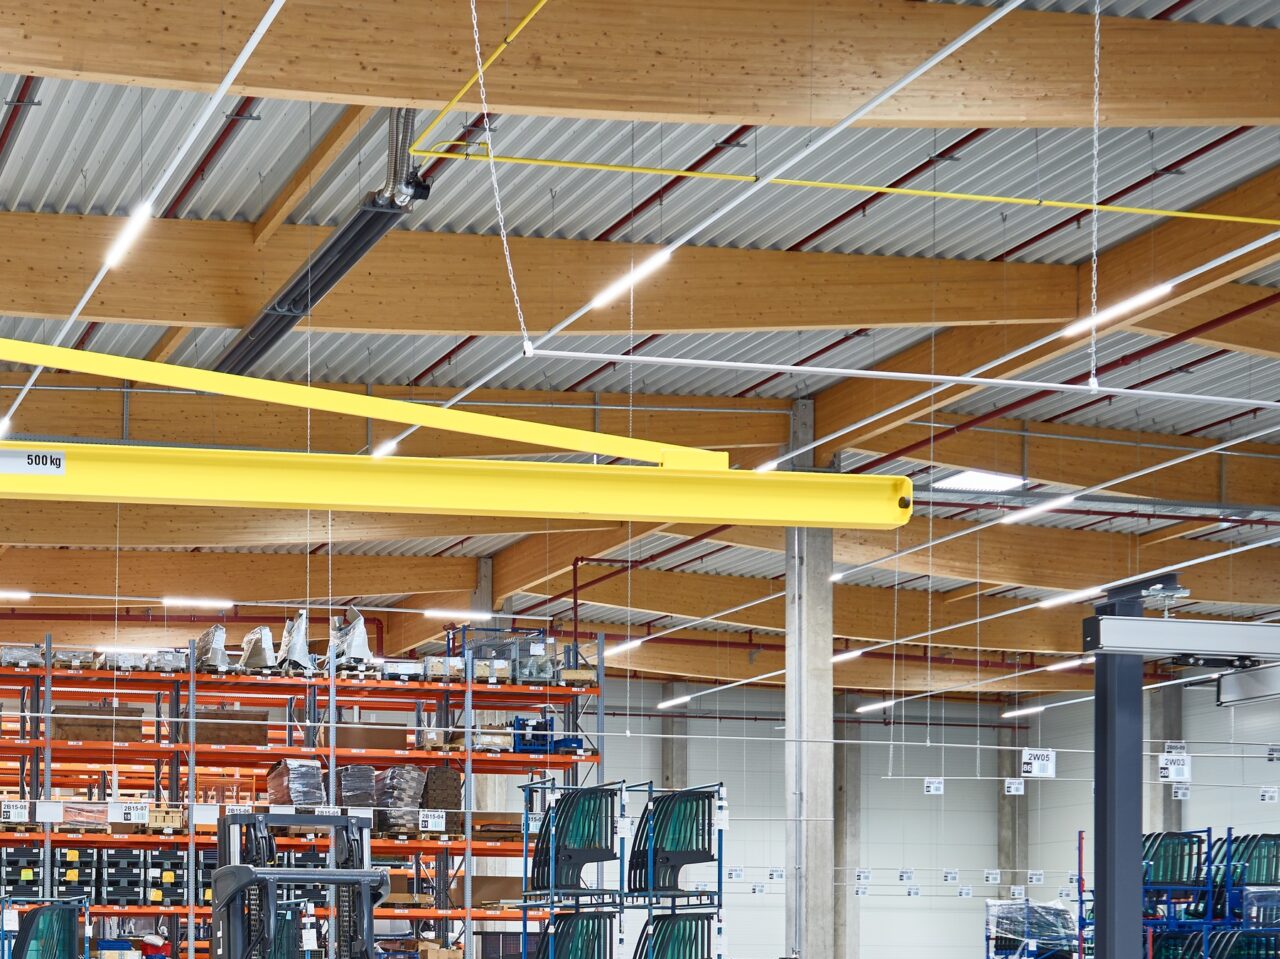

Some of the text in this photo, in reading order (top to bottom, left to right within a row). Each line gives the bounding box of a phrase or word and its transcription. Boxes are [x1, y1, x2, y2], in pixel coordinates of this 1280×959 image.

[27, 454, 61, 469] 500 kg
[1028, 753, 1050, 761] 2W05
[1164, 758, 1186, 766] 2W03
